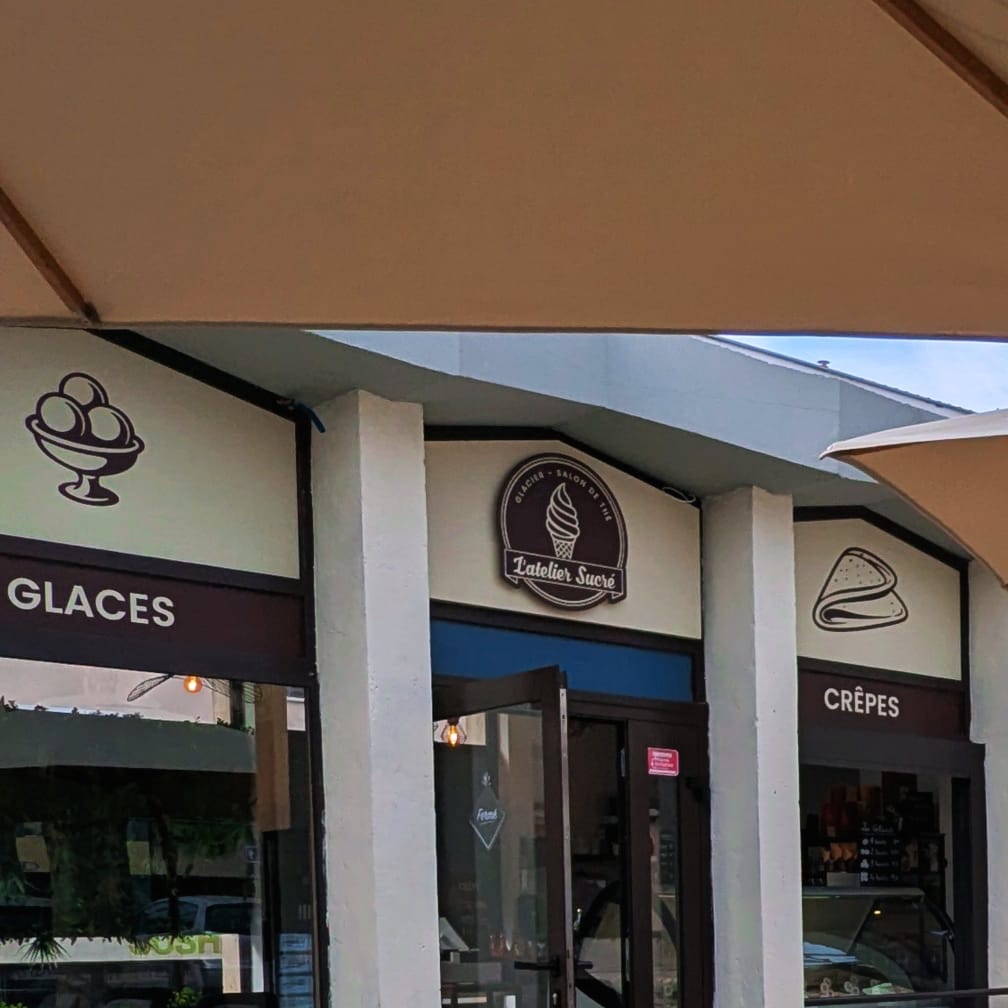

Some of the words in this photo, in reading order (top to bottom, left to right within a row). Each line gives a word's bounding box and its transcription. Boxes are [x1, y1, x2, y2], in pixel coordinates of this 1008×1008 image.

[514, 471, 545, 503] GLACIER
[556, 469, 587, 488] SALON
[588, 487, 599, 499] DE
[513, 556, 572, 582] L'atelier
[575, 565, 616, 589] Sucré
[7, 577, 176, 628] GLACES
[823, 685, 900, 718] CRÊPES
